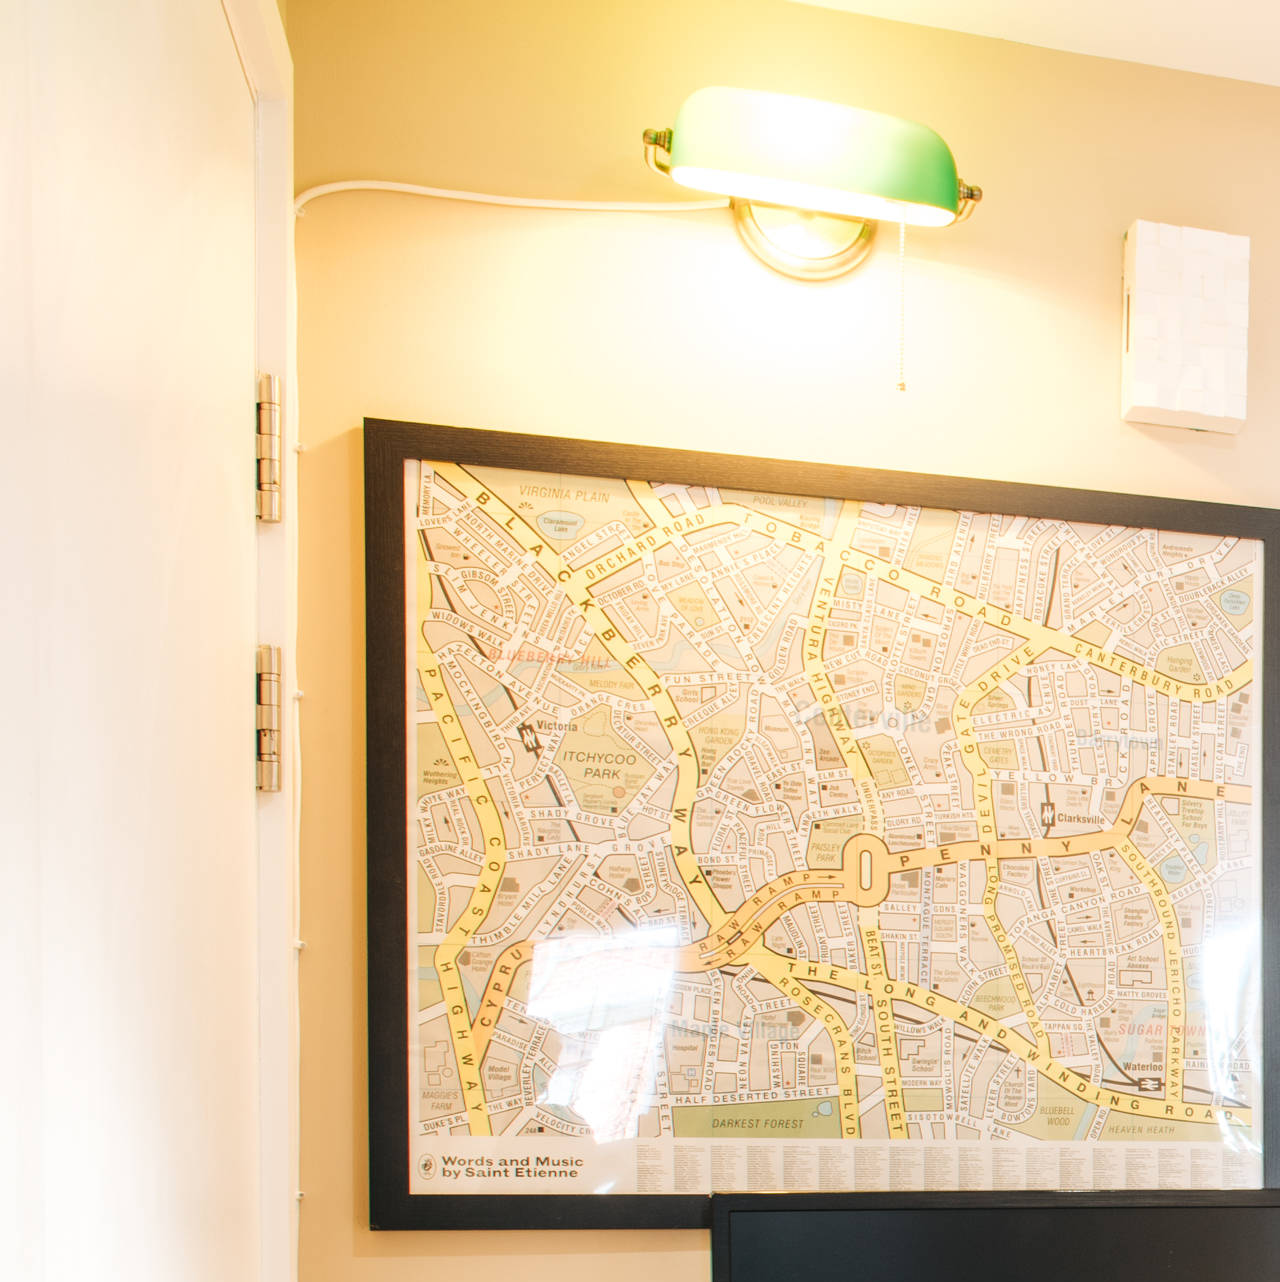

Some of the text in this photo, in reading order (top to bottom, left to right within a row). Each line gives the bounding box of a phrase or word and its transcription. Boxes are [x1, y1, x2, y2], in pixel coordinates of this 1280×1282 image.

[519, 485, 611, 504] VIRGINIA PLAIN
[465, 513, 495, 541] NORTH
[527, 570, 555, 599] DRIVE
[585, 513, 706, 582] ORCHARD ROAD
[743, 512, 1012, 627] TOBACCO ROAD
[431, 611, 474, 634] WIDOWS
[1067, 591, 1126, 632] MARLEY
[664, 673, 751, 685] FUN STREET
[807, 576, 858, 757] VENTURA HIGHWAY
[1075, 642, 1234, 699] CANTERBURY ROAD
[446, 660, 506, 751] MOCKINGBIRD
[476, 491, 703, 887] BLACKBERRY WAY
[508, 679, 560, 716] AVENUE
[571, 694, 646, 715] ORANGE CRES
[424, 667, 488, 807] PACIFIC
[537, 719, 578, 732] Victoria
[957, 646, 1034, 835] DEVIL GATE DRIVE
[978, 721, 1062, 742] THE WRONG ROAD
[993, 770, 1074, 783] YELLOW
[1119, 683, 1131, 736] ROAD
[1166, 700, 1178, 776] STANLEY ROAD
[1190, 703, 1201, 778] BEASLEY STREET
[519, 732, 563, 789] PERFECT WAY
[563, 750, 637, 766] ITCHYCOO
[584, 767, 621, 780] PARK
[767, 762, 801, 782] EASY ST
[818, 770, 837, 780] ELM
[896, 738, 924, 785] LONELY
[1215, 741, 1225, 779] VULCAN
[530, 808, 615, 826] SHADY GROVE
[900, 782, 1225, 866] PENNY LANE
[1057, 813, 1105, 826] Clarksville
[508, 843, 590, 859] SHADY LANE
[697, 854, 735, 864] BOND ST
[1092, 853, 1104, 875] OAK
[459, 836, 501, 937] COAST
[471, 856, 573, 942] THIMBLE MILL LANE
[921, 870, 932, 929] MONTAGUE
[959, 862, 968, 940] WAGGONERS
[1061, 896, 1106, 914] CANYON
[1109, 886, 1141, 901] ROAD
[698, 918, 741, 949] RAW
[753, 872, 809, 906] RAMP
[727, 890, 839, 958] RAW RAMP
[865, 929, 881, 960] BEAT
[985, 865, 1045, 1041] LONG PROMISED ROAD
[1135, 928, 1160, 946] ROAD
[1121, 843, 1181, 1099] SOUTHBOUND JERICHO PARKWAY
[1054, 999, 1078, 1015] COLD
[439, 961, 484, 1113] HIGHWAY
[787, 962, 1234, 1120] THE LONG AND WINDING ROAD
[1117, 1024, 1163, 1036] SUGAR
[524, 1024, 547, 1107] BEVERLEY TERRACE
[779, 977, 857, 1136] ROSECRANS BLVD
[876, 998, 904, 1132] SOUTH STREET
[1123, 1062, 1164, 1073] Waterloo
[675, 1087, 830, 1104] HALF DESERTED STREET
[711, 1117, 804, 1129] DARKEST FOREST
[1107, 1125, 1175, 1134] HEAVEN HEATH
[441, 1155, 584, 1167] Words and Music
[441, 1166, 579, 1179] by Saint Etienne
